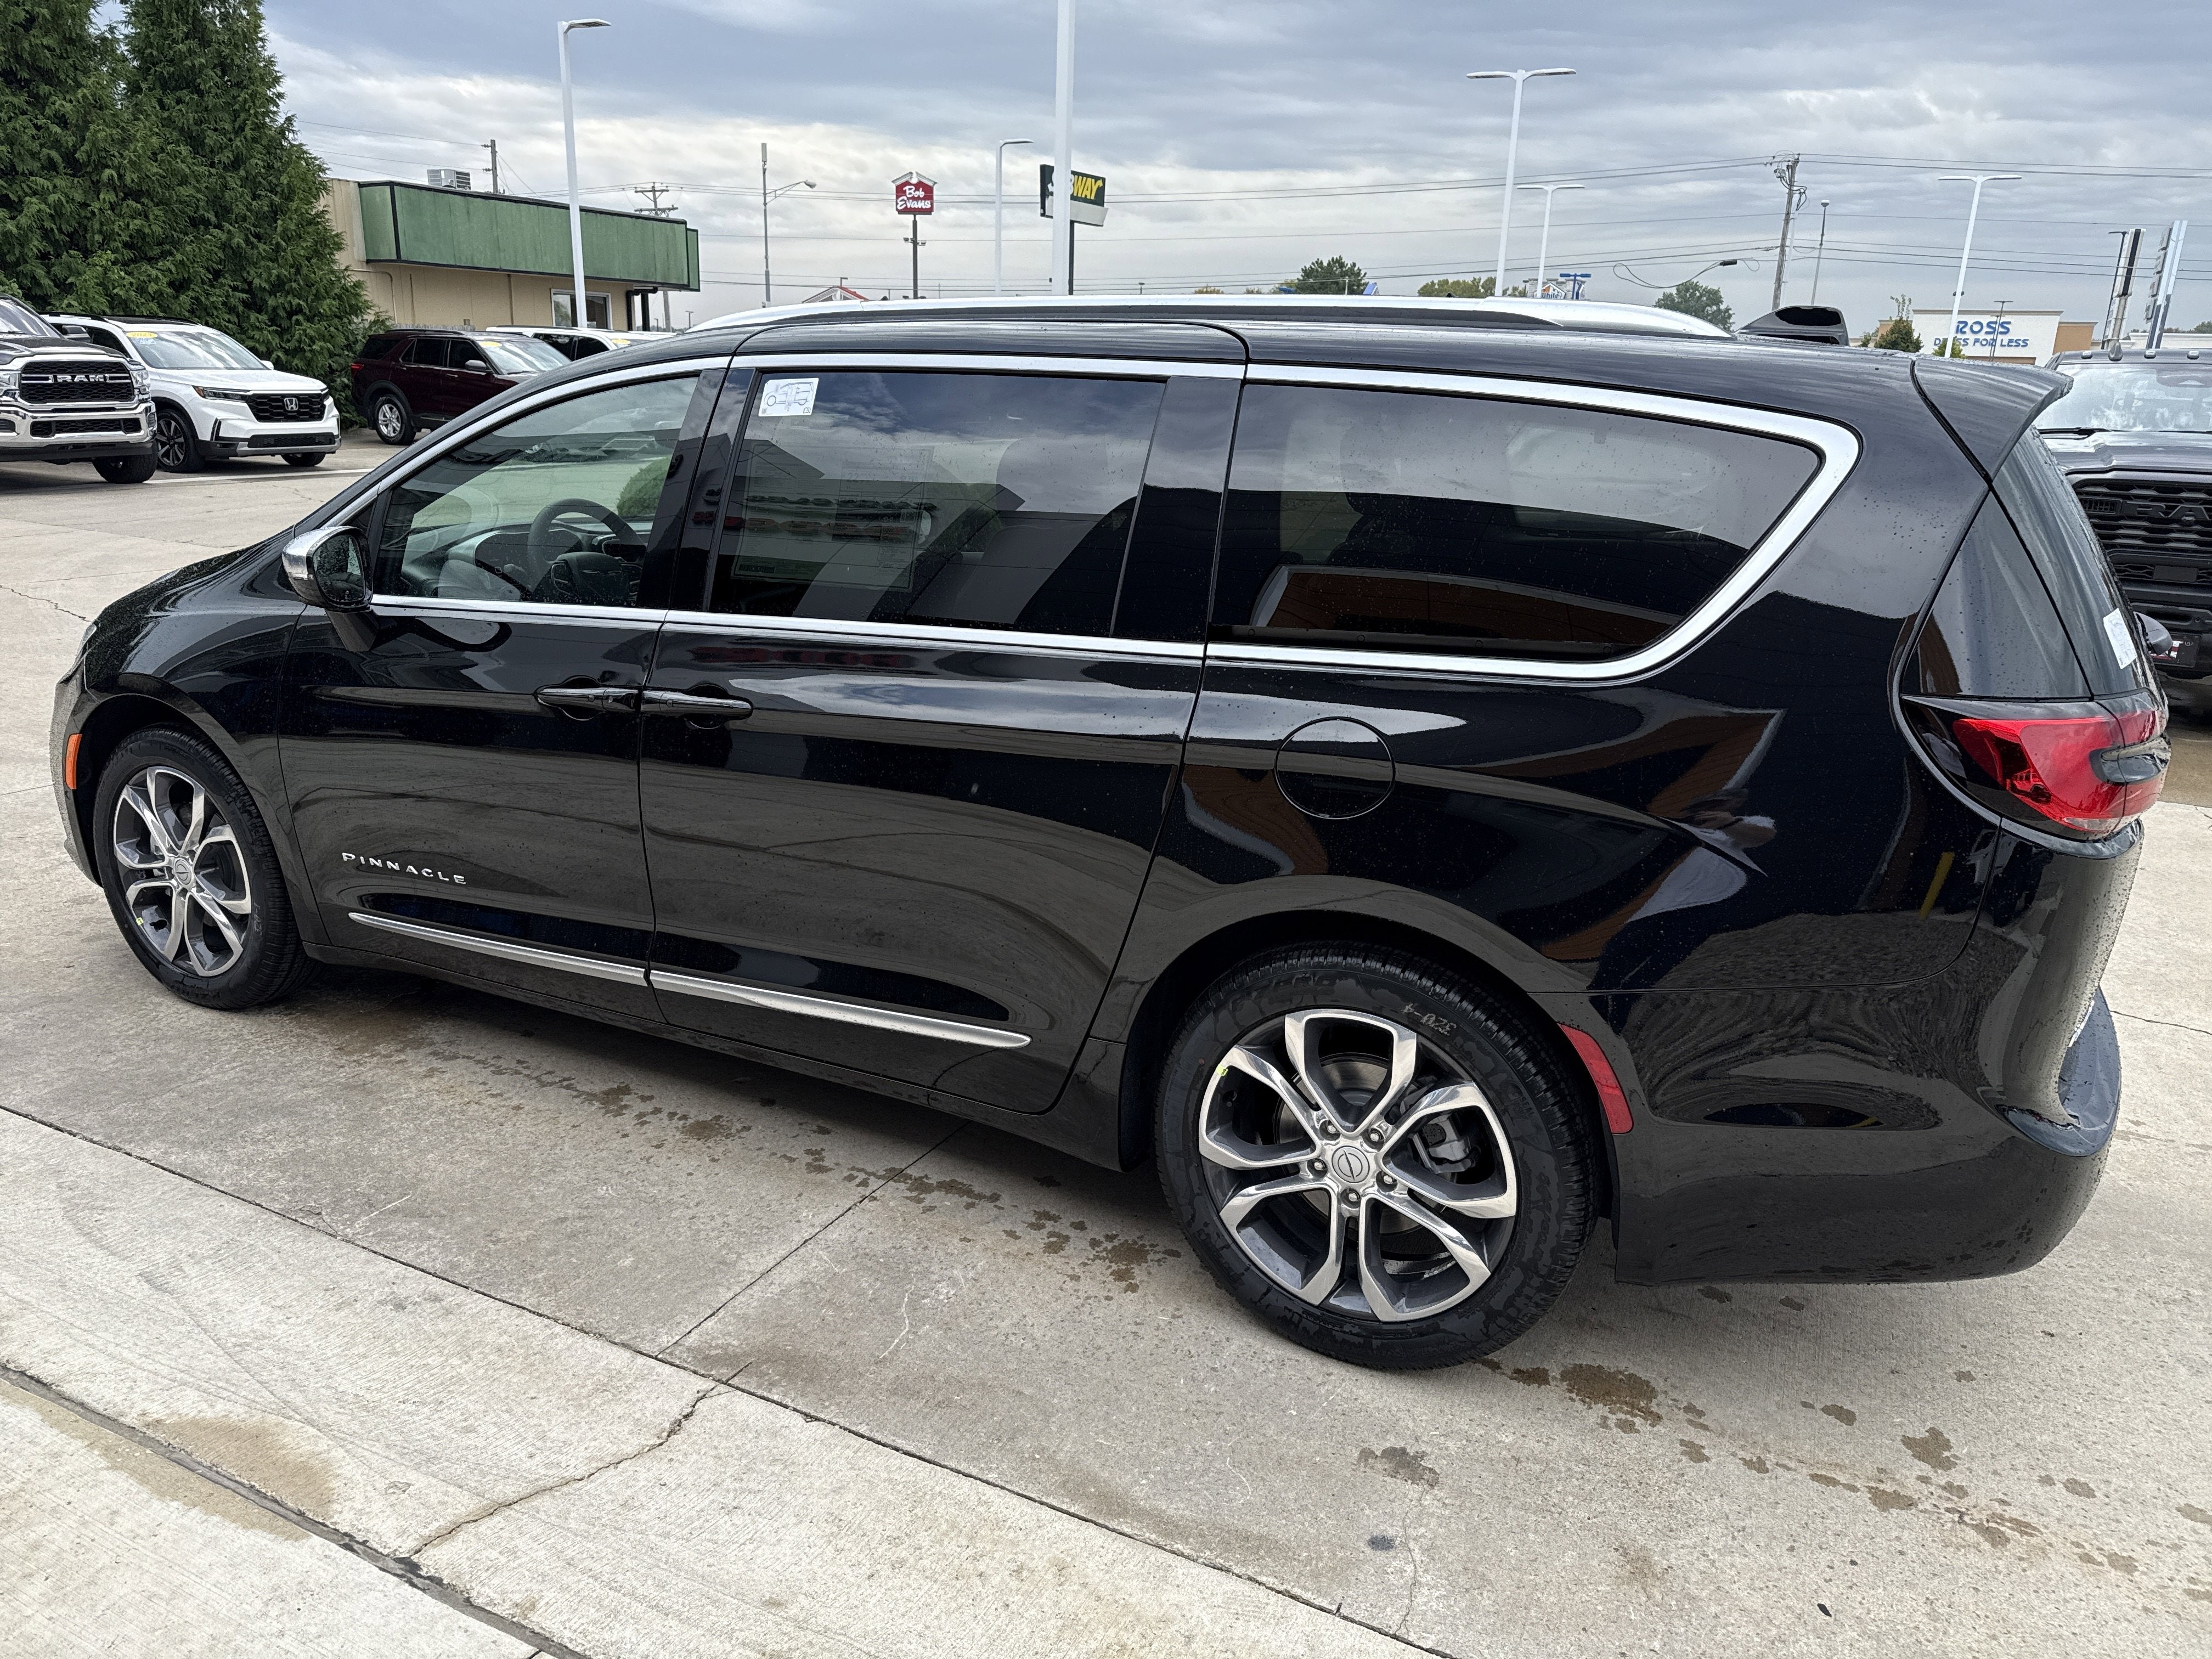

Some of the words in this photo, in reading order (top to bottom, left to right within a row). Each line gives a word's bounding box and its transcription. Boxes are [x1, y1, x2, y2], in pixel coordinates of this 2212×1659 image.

[902, 185, 924, 198] Bob
[897, 196, 931, 210] Evans
[1956, 320, 2012, 335] ROSS
[1933, 337, 1970, 347] DSS
[1973, 338, 1995, 347] FOR
[2000, 338, 2029, 347] LESS
[342, 852, 466, 884] PINNACLE
